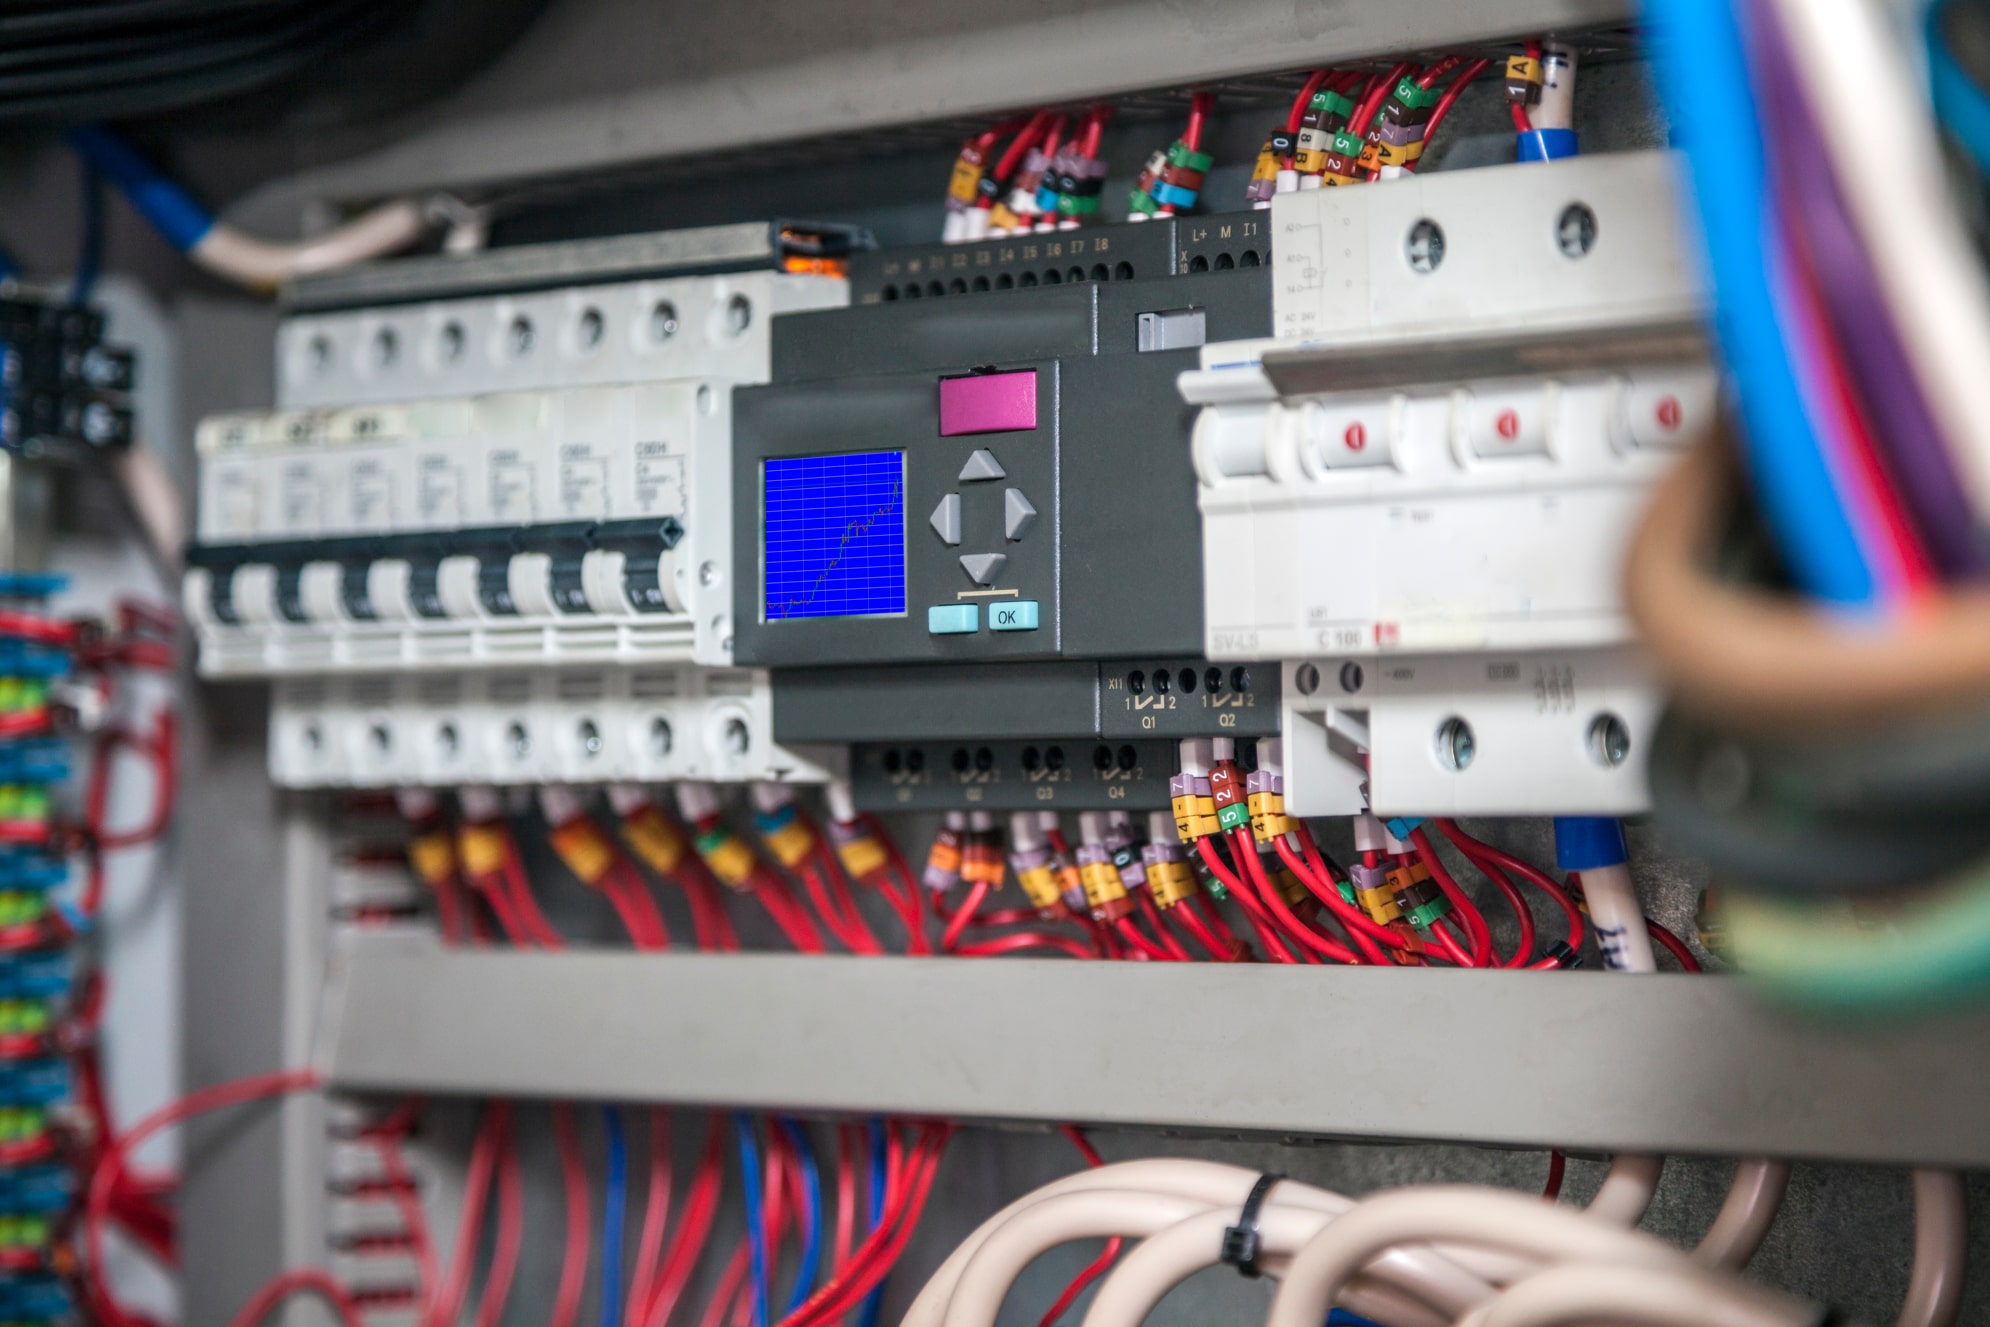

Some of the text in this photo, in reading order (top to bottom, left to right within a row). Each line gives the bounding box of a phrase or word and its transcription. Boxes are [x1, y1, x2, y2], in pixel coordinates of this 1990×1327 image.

[1193, 228, 1208, 242] L+
[1220, 225, 1232, 239] M
[998, 610, 1016, 624] OK
[1108, 678, 1123, 690] X11
[1142, 716, 1156, 729] Q1
[1219, 713, 1236, 727] Q2
